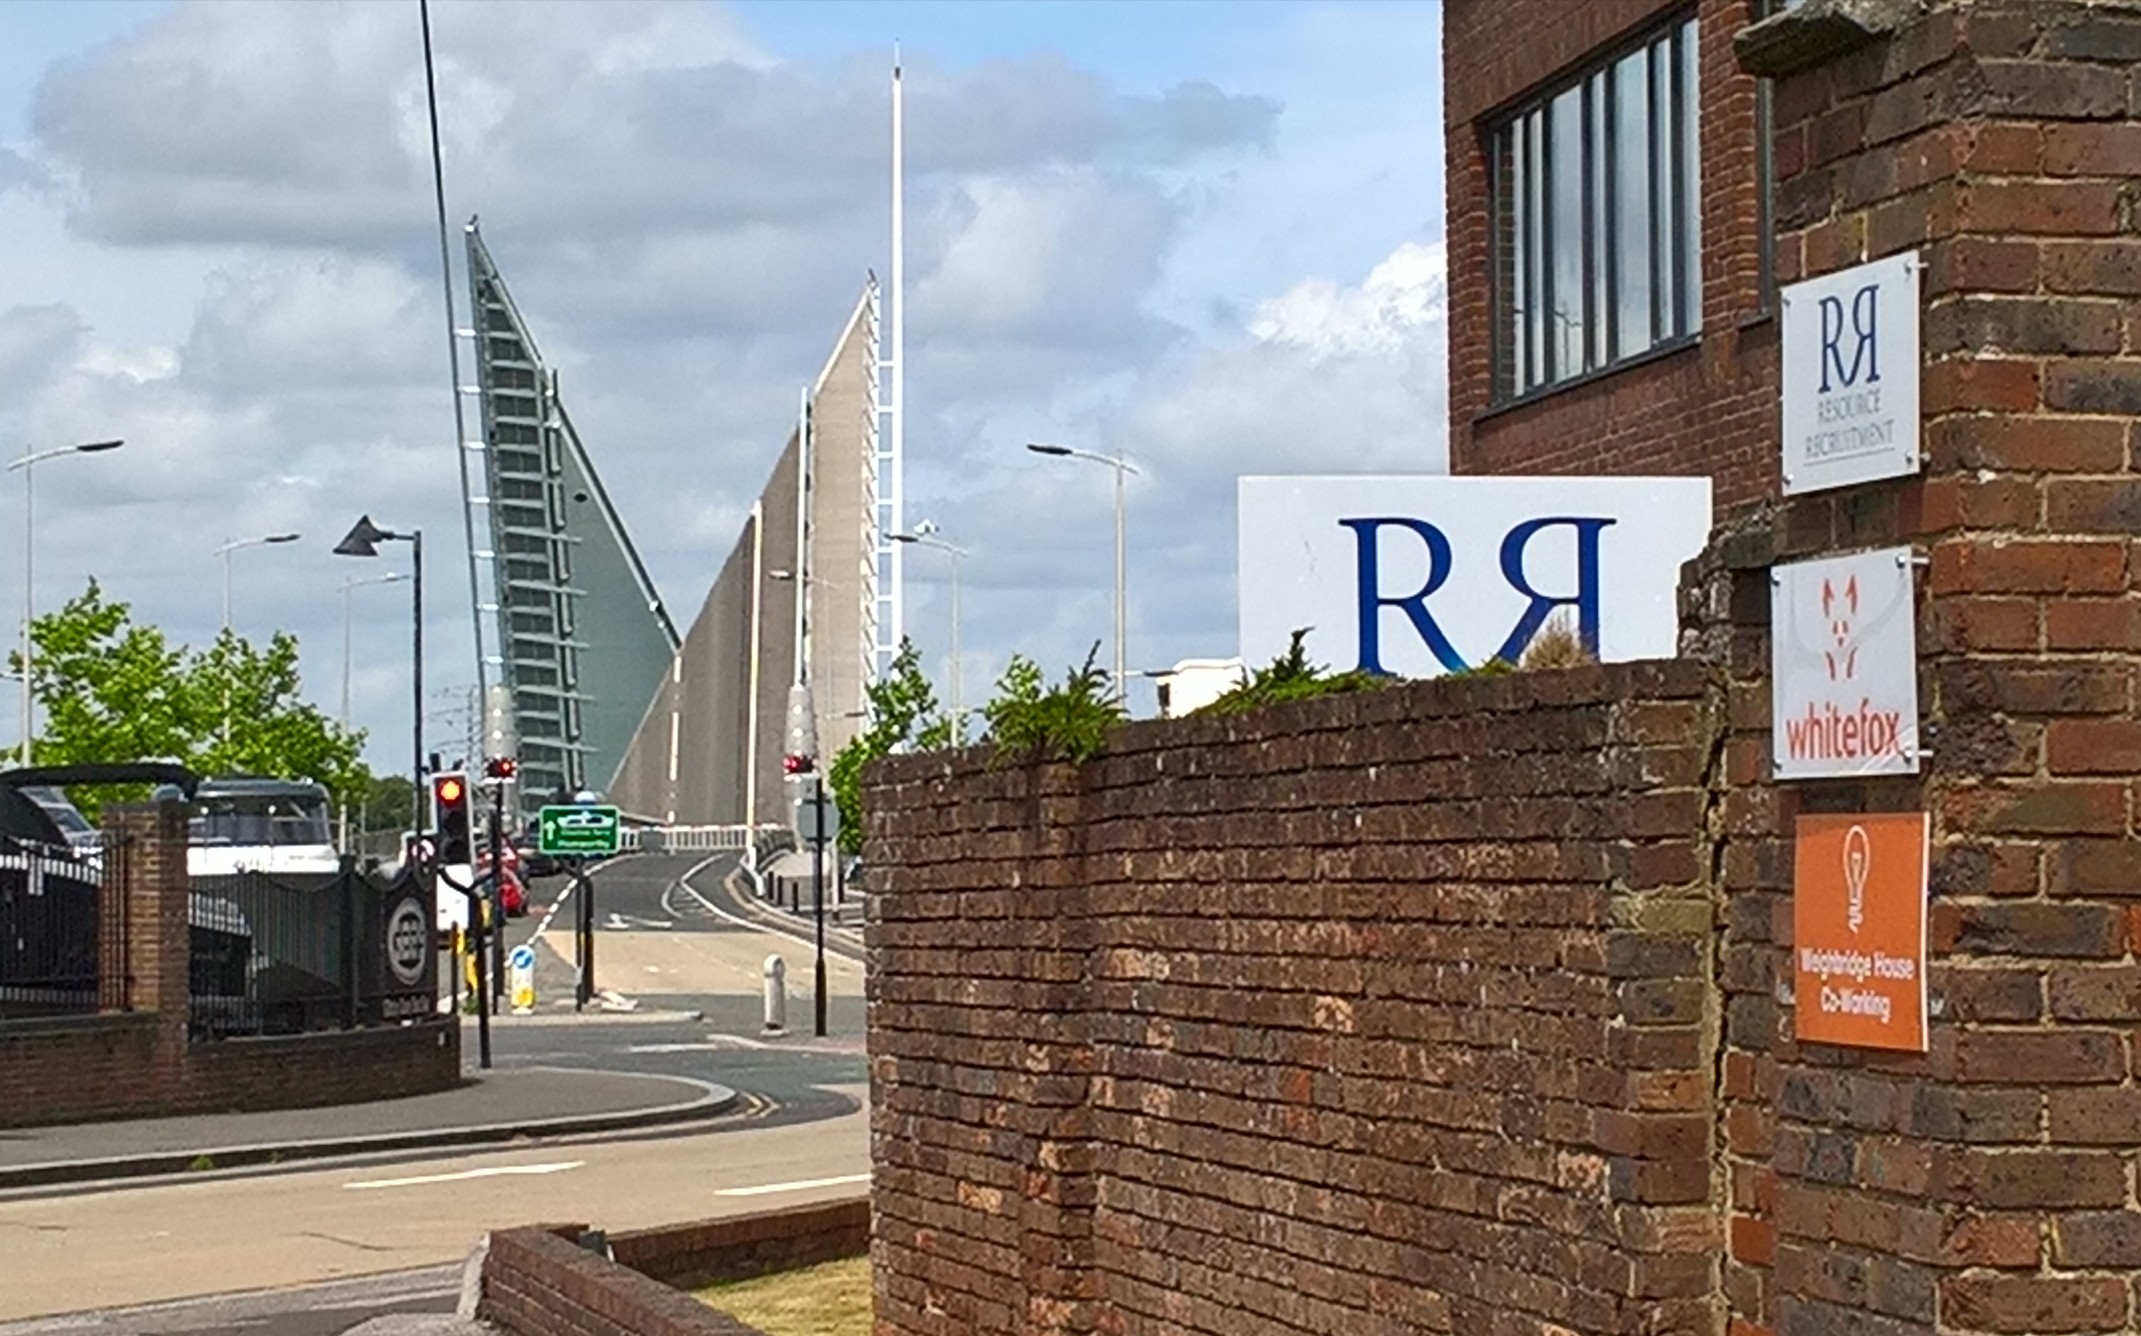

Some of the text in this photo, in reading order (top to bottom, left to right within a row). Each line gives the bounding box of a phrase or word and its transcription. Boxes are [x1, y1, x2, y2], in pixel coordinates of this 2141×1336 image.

[1817, 387, 1881, 425] RESOURCE
[1804, 418, 1895, 459] RECRUITMENT
[1786, 697, 1900, 760] whitefox
[1873, 951, 1915, 980] House
[1820, 986, 1891, 1025] Co-Working
